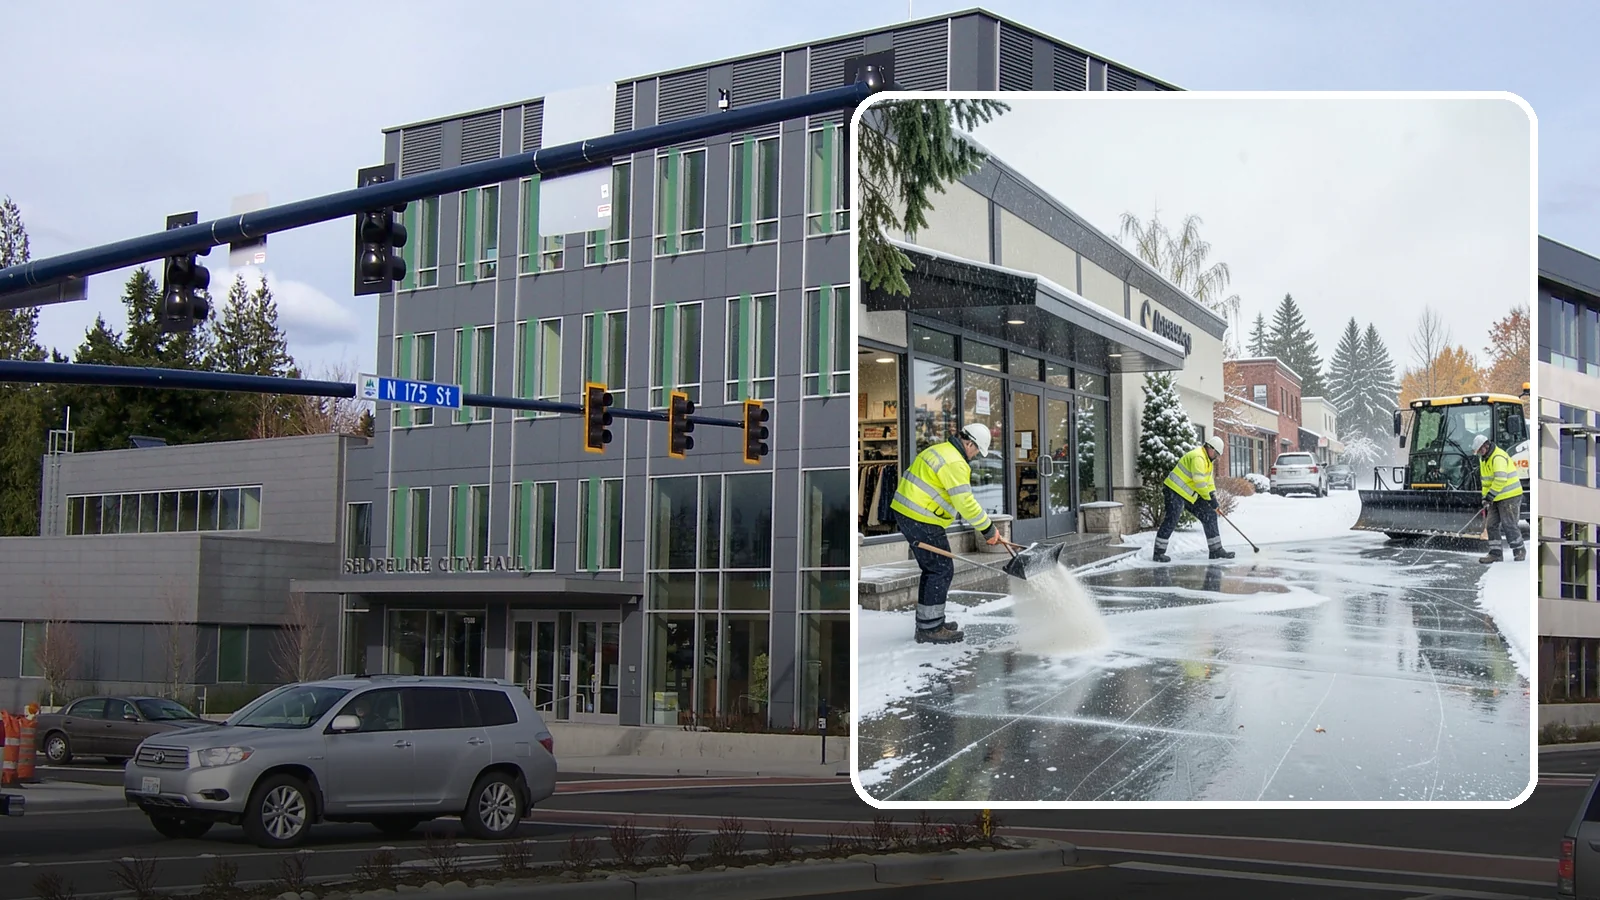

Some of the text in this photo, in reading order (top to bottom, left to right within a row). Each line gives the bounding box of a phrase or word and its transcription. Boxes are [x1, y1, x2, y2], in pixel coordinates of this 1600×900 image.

[387, 380, 451, 406] N 175 St
[343, 556, 525, 573] SHORELINE CITY HALL
